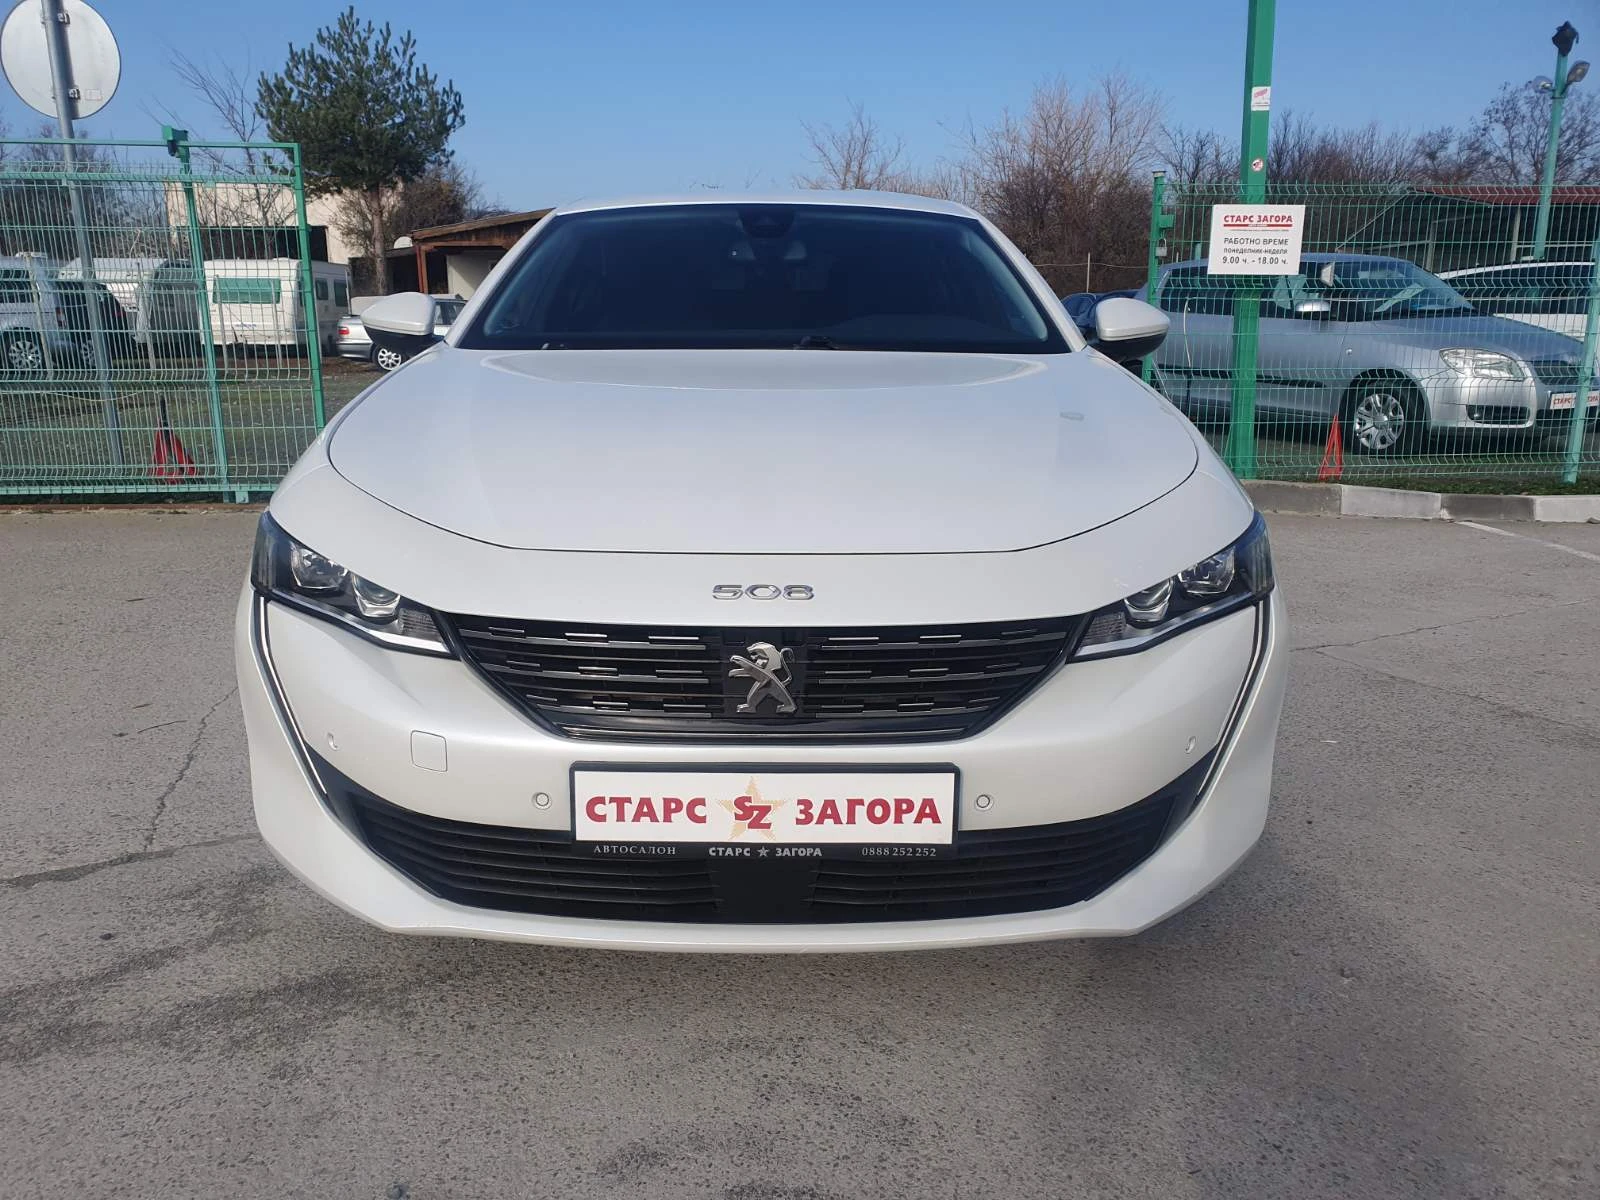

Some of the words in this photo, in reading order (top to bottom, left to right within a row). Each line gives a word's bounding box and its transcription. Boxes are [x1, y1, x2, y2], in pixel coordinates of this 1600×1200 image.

[1223, 214, 1254, 223] СТАРС
[1256, 215, 1293, 223] ЗАГОРА
[1223, 237, 1260, 245] РАБОТНО
[1262, 238, 1289, 246] ВРЕМЕ
[1222, 256, 1240, 264] 9.00
[1258, 256, 1279, 264] 18.00
[712, 584, 815, 600] 508
[585, 796, 707, 823] СТАРС
[733, 795, 772, 830] SZ
[795, 798, 942, 825] ЗАГОРА
[593, 845, 676, 855] АВТОСАЛОН
[709, 847, 751, 857] СТАРС
[775, 848, 822, 857] ЗАГОРА
[861, 847, 890, 857] 0888
[891, 847, 914, 857] 252
[915, 847, 937, 857] 252
